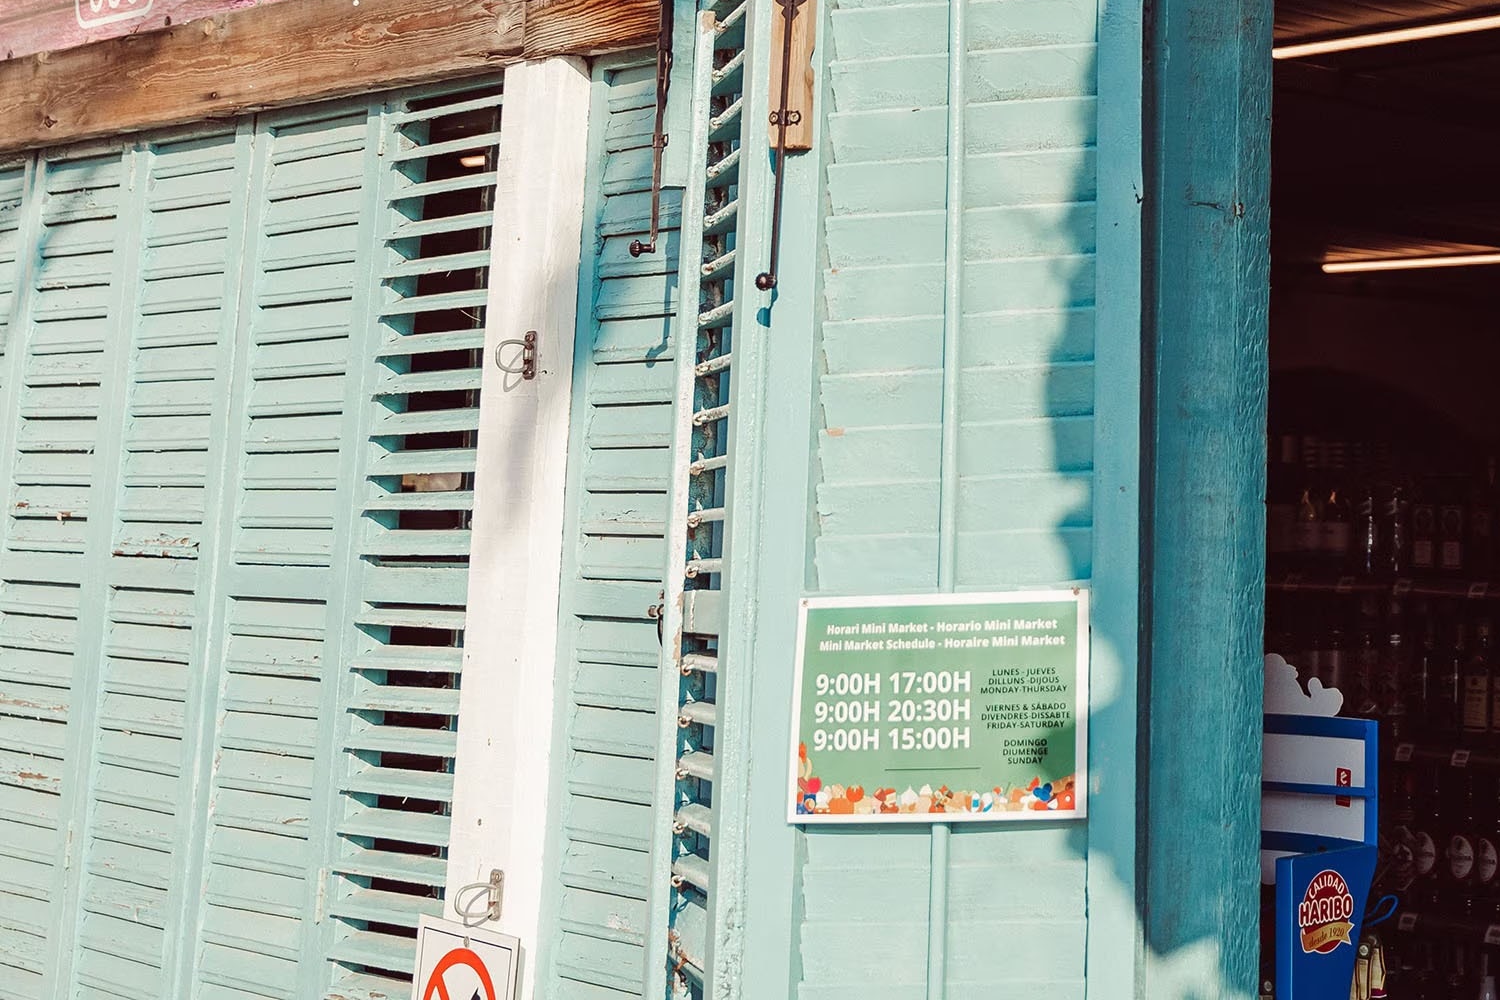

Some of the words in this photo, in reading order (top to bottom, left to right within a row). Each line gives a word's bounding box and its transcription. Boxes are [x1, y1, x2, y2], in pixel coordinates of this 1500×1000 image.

[827, 623, 860, 635] Horari
[862, 622, 886, 634] Mini
[888, 622, 928, 633] Market
[937, 620, 982, 632] Horario
[984, 619, 1011, 631] Mini
[1013, 618, 1058, 630] Market
[819, 640, 842, 652] Mini
[844, 639, 884, 651] Market
[886, 638, 936, 650] Schedule
[944, 636, 990, 648] Horaire
[992, 635, 1019, 647] Mini
[1021, 634, 1066, 646] Market
[992, 668, 1020, 676] LUNES
[1026, 667, 1056, 677] JUEVES
[816, 673, 881, 696] 9:00H
[888, 671, 971, 694] 17:00H
[988, 677, 1025, 685] DILLUNS
[814, 700, 880, 724] 9:00H
[887, 699, 971, 723] 20:30H
[985, 703, 1020, 712] VIERNES
[987, 720, 1065, 729] FRIDAY-SATURDAY
[813, 728, 880, 751] 9:00H
[888, 727, 971, 750] 15:00H
[1004, 739, 1048, 747] DOMINGO
[1003, 747, 1049, 756] DIUMENGE
[1008, 756, 1044, 765] SUNDAY
[1309, 874, 1345, 899] CALIDAD
[1299, 893, 1354, 928] HARIBO
[1309, 929, 1328, 947] desde
[1329, 926, 1345, 938] 1920
